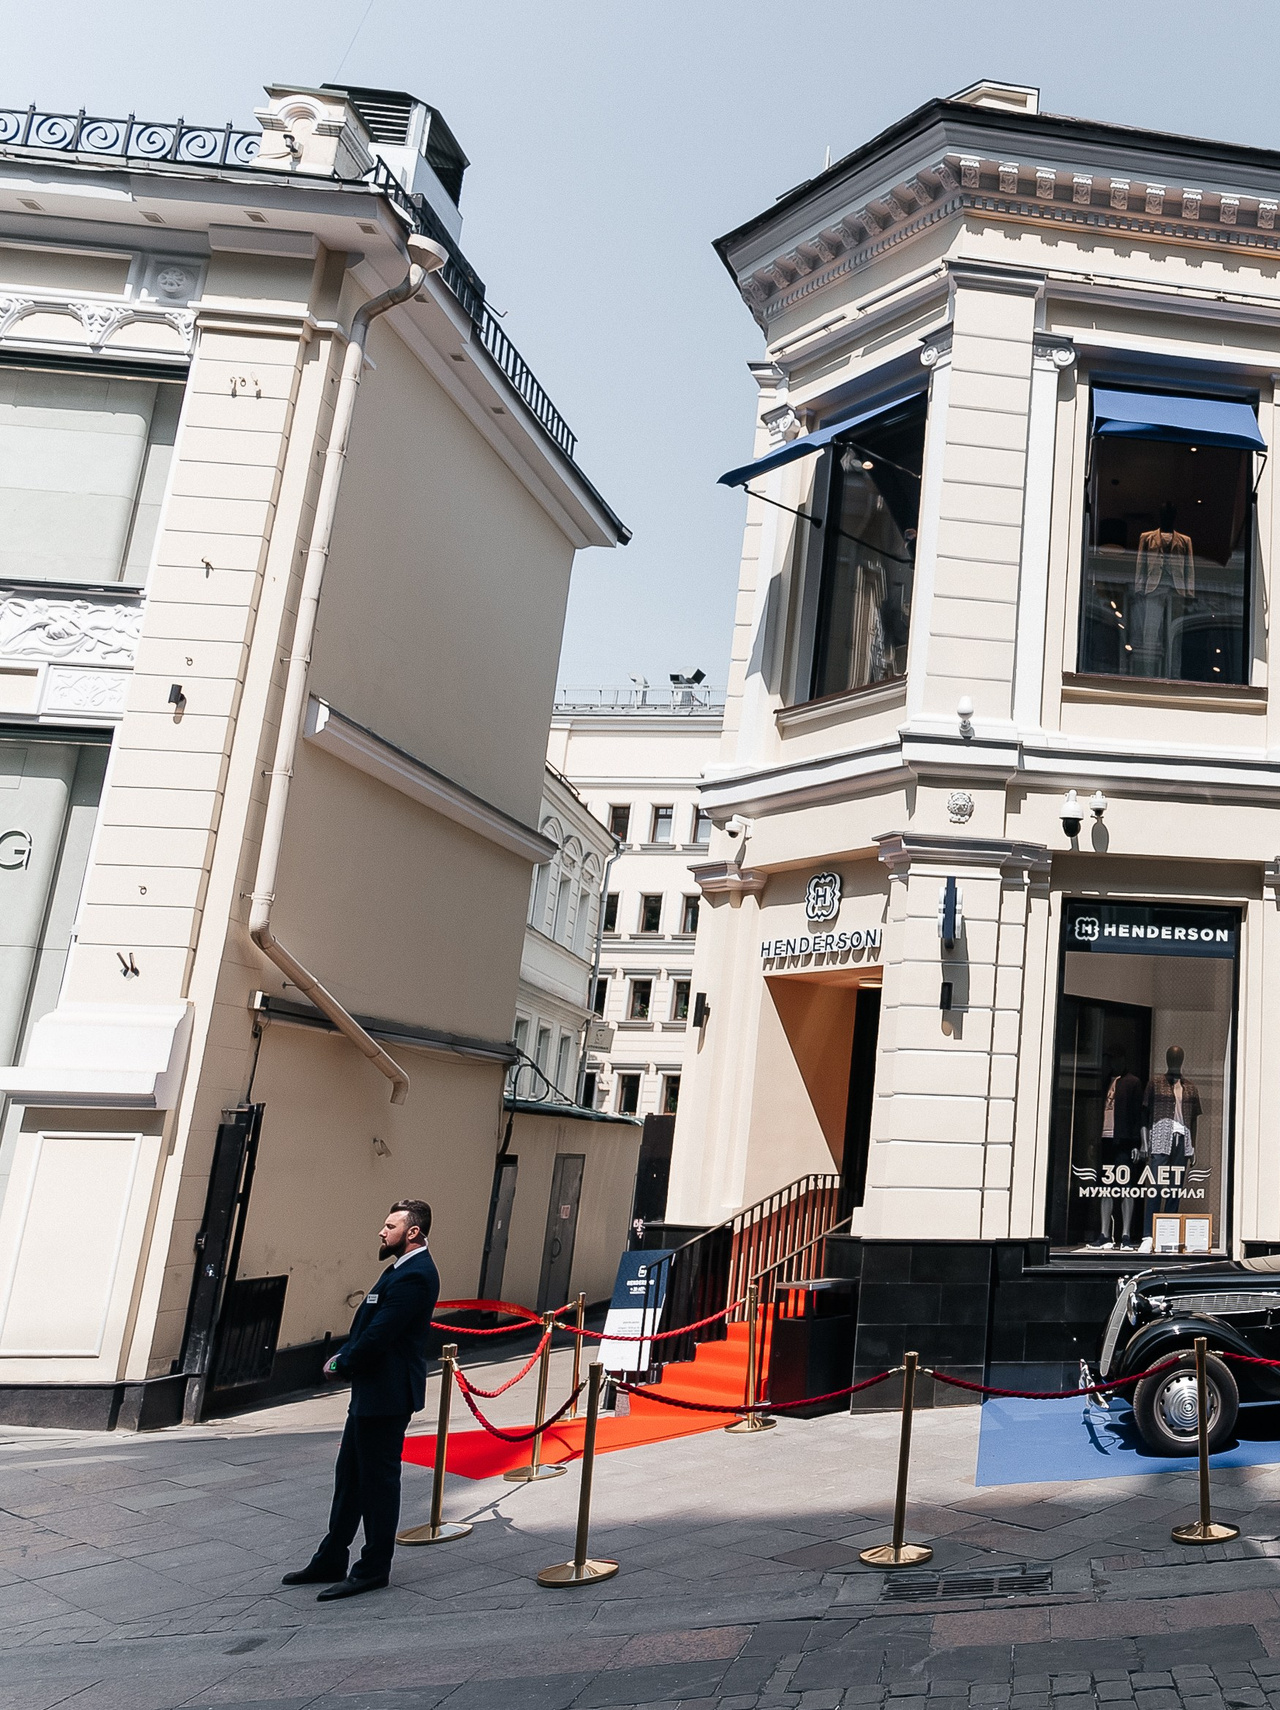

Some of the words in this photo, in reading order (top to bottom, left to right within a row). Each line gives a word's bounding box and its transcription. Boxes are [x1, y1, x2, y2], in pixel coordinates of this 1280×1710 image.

[1103, 923, 1229, 942] HENDERSON
[760, 929, 878, 958] HENDERSON
[1101, 1164, 1131, 1186] 30
[1137, 1164, 1186, 1186] ЛЕТ
[1078, 1186, 1158, 1199] МУЖСКОГО
[1160, 1187, 1206, 1199] СТИЛЯ
